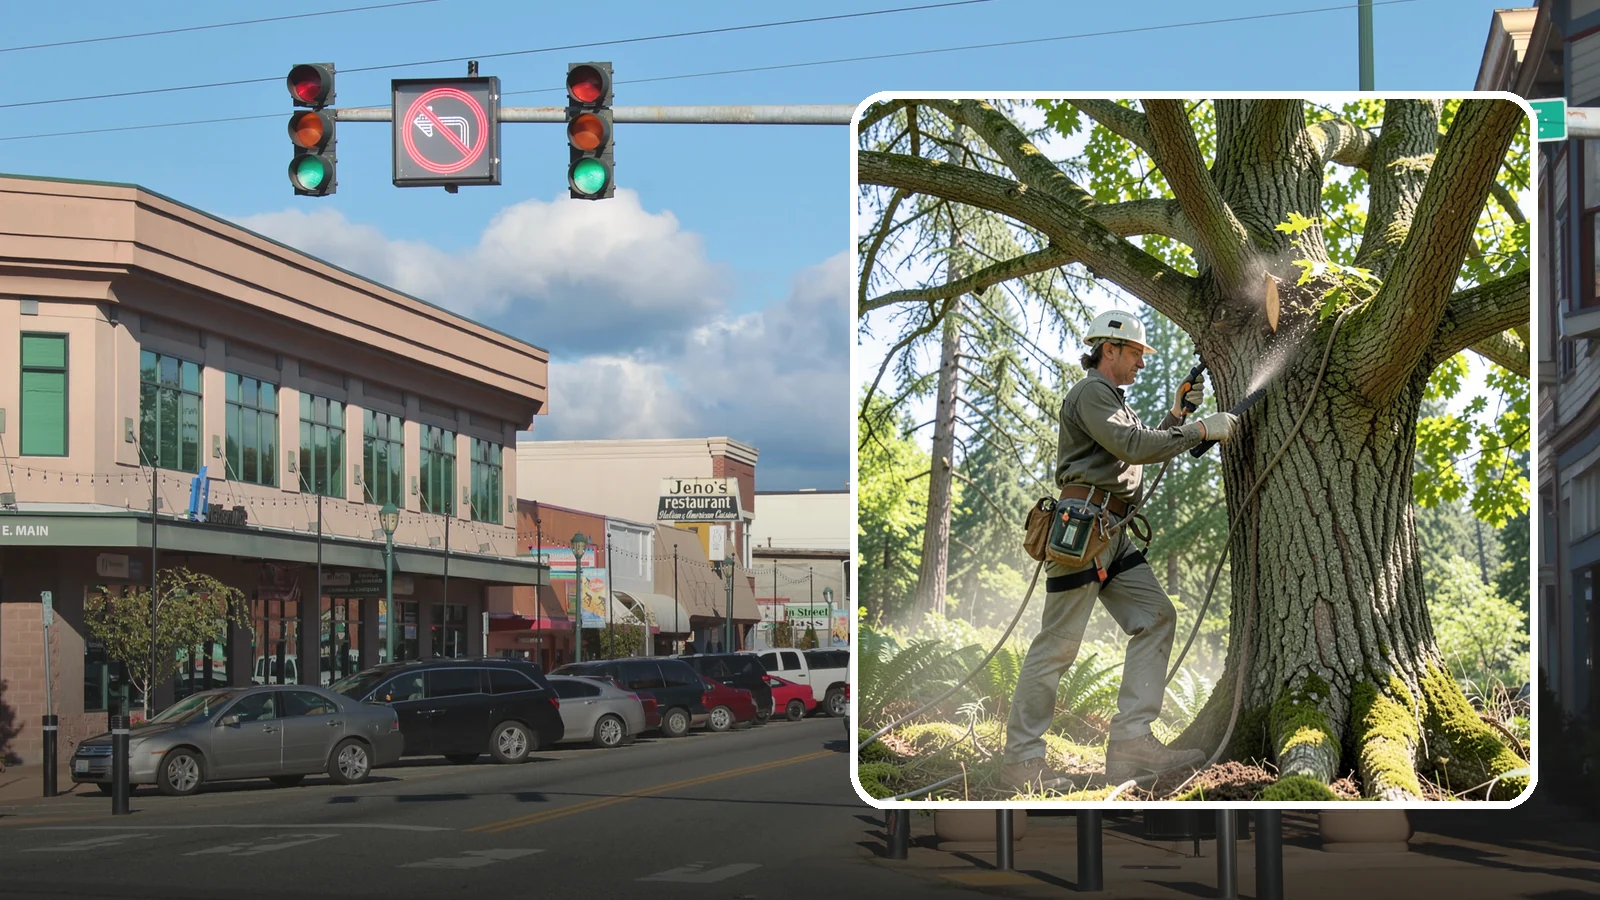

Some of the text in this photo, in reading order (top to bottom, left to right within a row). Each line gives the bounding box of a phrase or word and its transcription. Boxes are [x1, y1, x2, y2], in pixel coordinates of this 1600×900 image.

[670, 480, 727, 494] Jeno's
[665, 496, 731, 509] restaurant
[658, 510, 682, 520] Italian
[686, 510, 715, 519] American
[715, 509, 738, 519] Cuisine
[2, 525, 49, 536] E. MAIN
[797, 607, 828, 617] Street
[790, 619, 823, 627] lass
